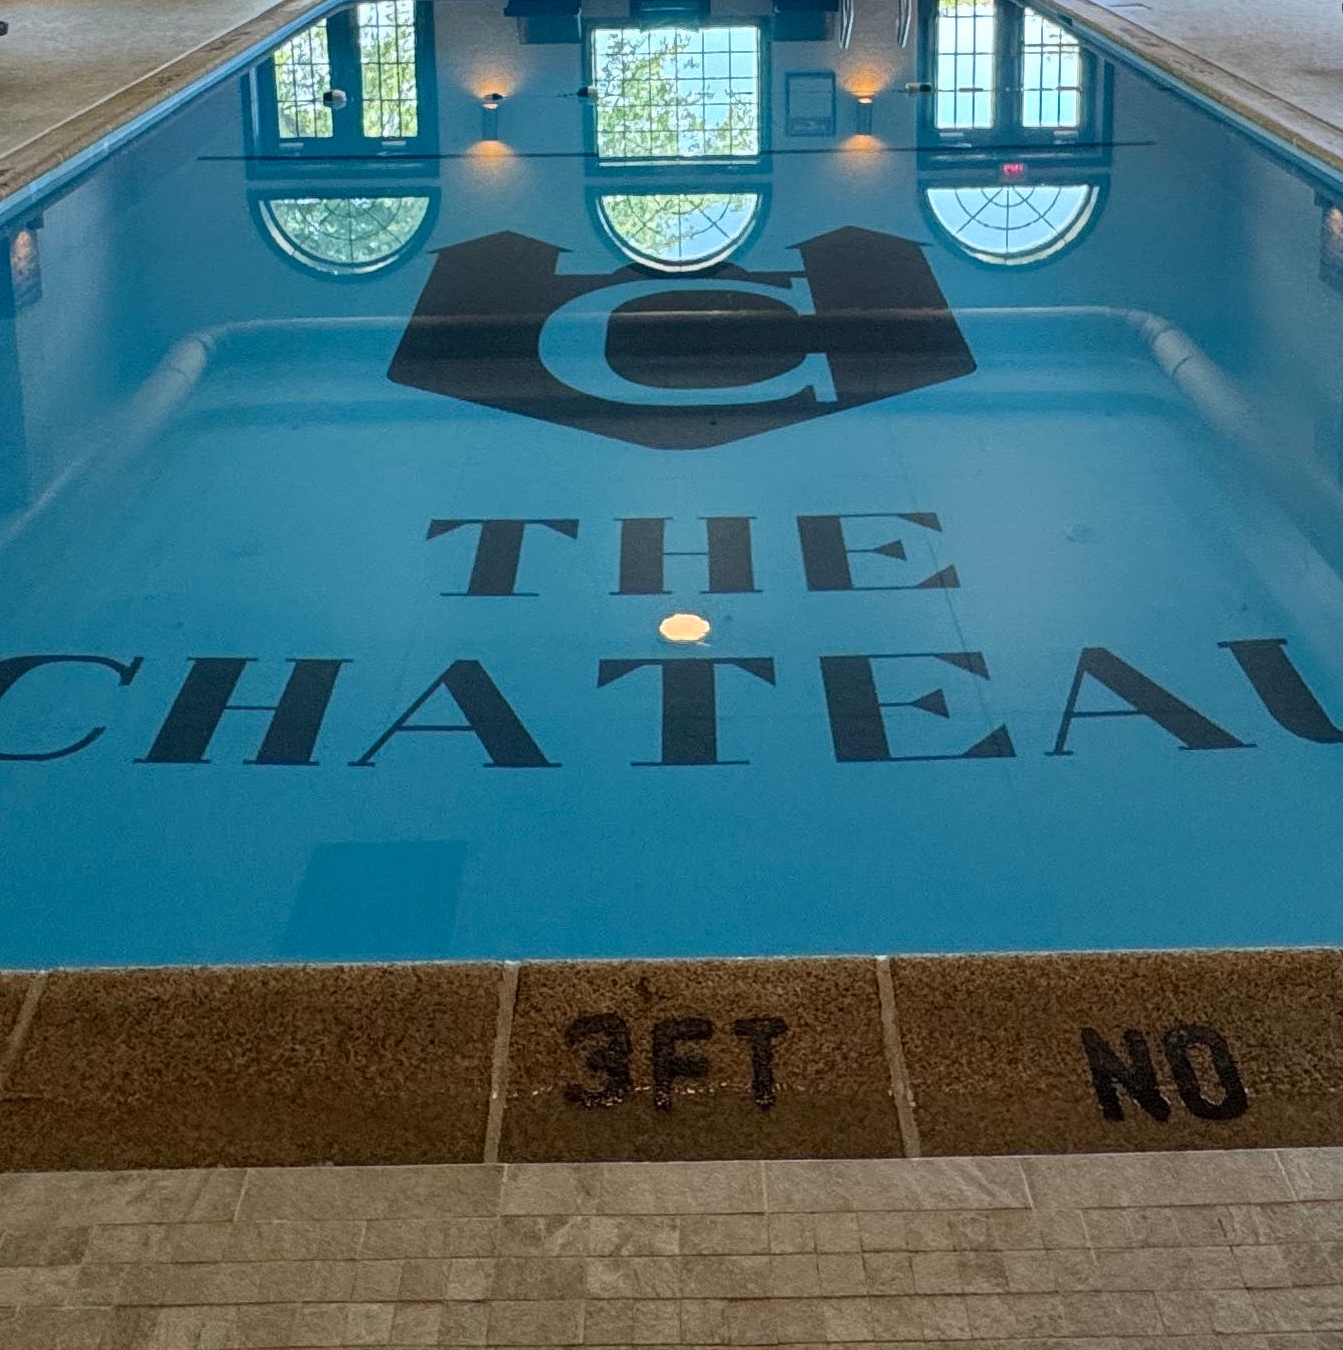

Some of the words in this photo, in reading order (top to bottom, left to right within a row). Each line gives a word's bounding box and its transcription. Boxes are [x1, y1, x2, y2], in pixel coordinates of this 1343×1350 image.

[538, 277, 838, 407] C
[426, 511, 960, 596] THE
[564, 1012, 788, 1110] 3FT
[1080, 1023, 1250, 1123] NO
